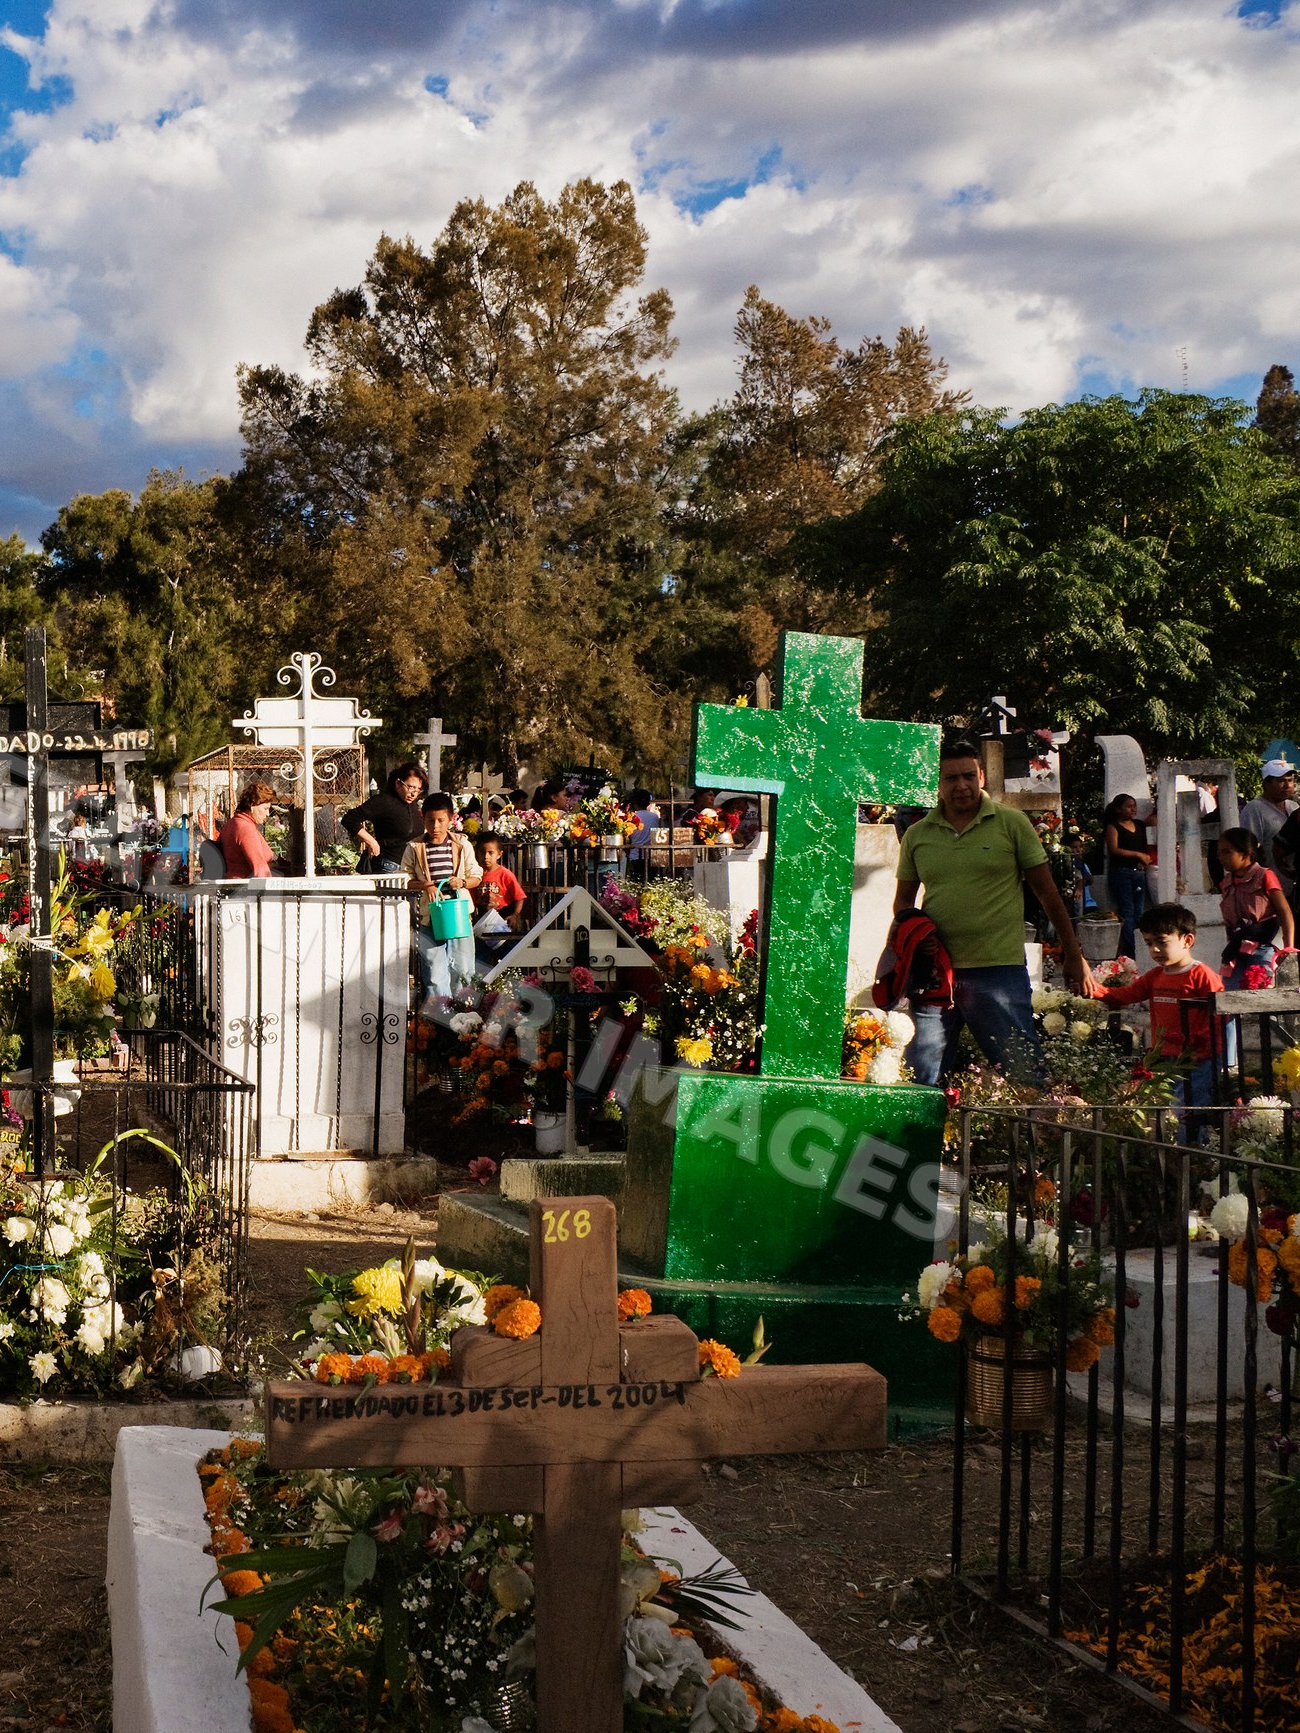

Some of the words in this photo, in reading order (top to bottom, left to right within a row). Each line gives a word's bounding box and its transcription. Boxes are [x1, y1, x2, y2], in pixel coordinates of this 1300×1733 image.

[655, 830, 668, 844] 65
[228, 909, 248, 923] 161
[541, 1209, 592, 1244] 268
[272, 1394, 419, 1424] REFRENDADO
[422, 1391, 446, 1417] EL
[447, 1390, 466, 1418] 3
[468, 1388, 497, 1412] DE
[606, 1380, 686, 1409] 2004
